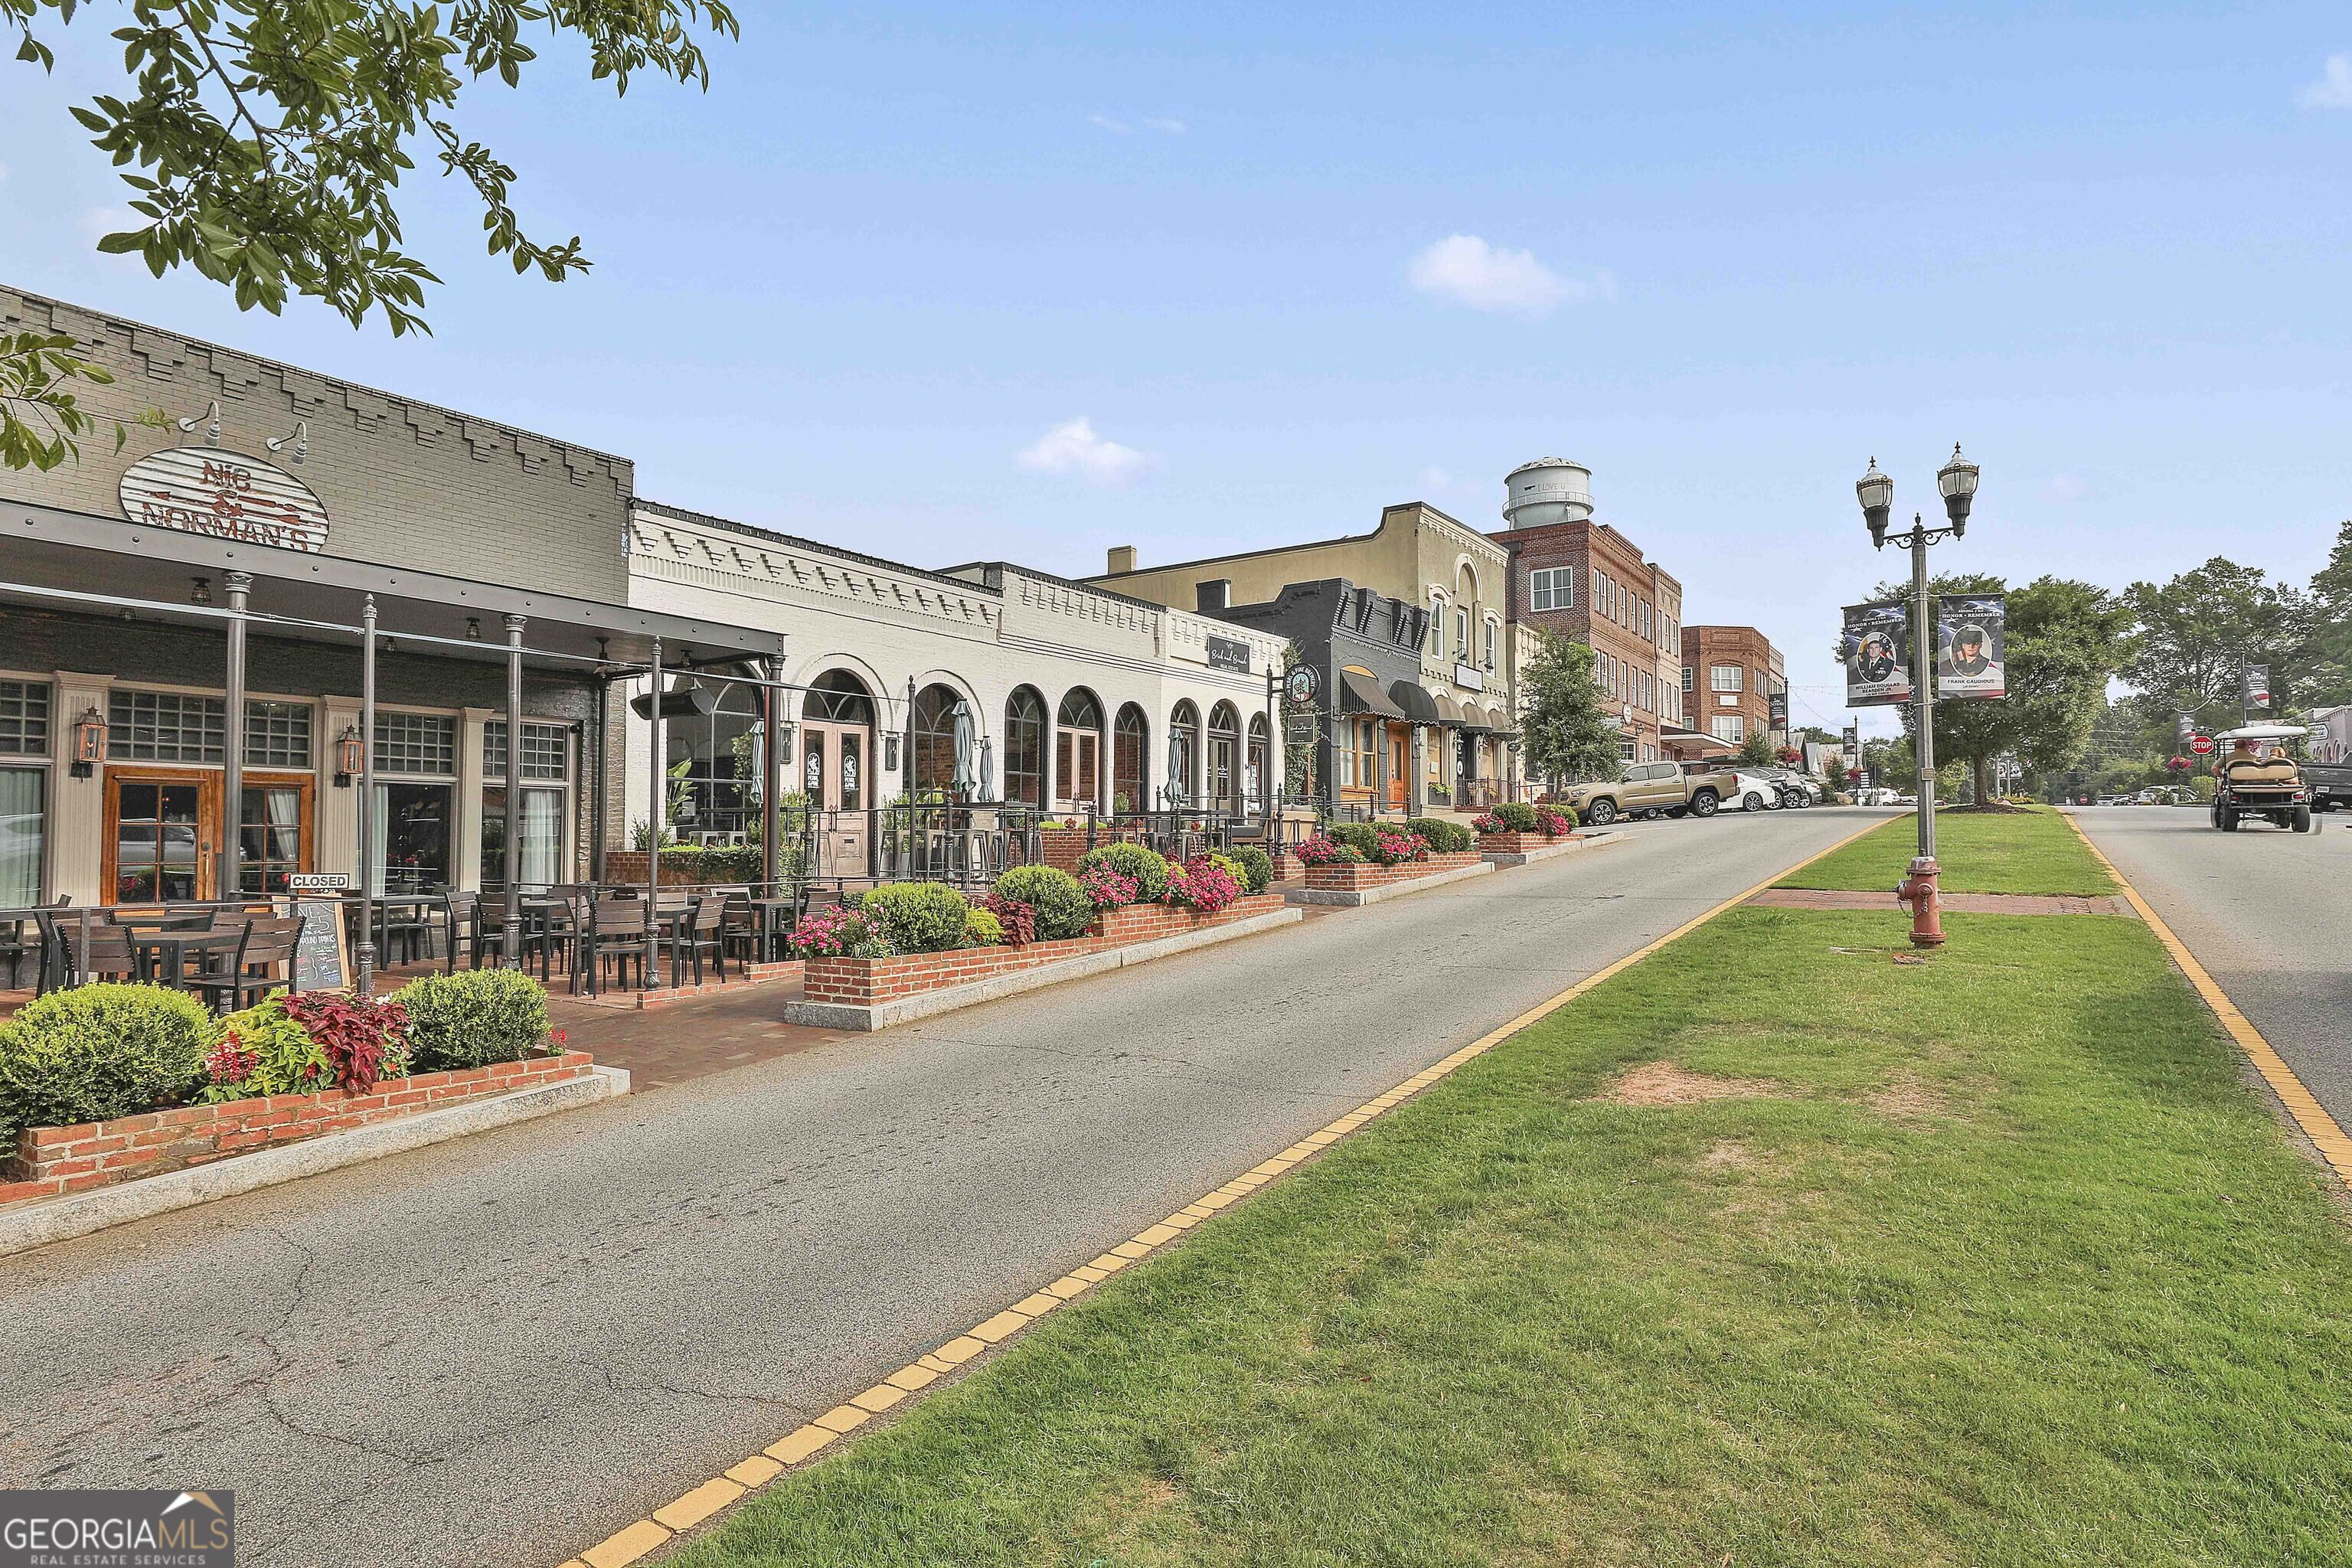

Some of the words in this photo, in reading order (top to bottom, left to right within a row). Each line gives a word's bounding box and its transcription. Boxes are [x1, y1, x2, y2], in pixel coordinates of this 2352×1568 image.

[142, 502, 309, 552] NORMAN'S
[1304, 668, 1316, 688] BREWERY
[292, 876, 346, 887] CLOSED
